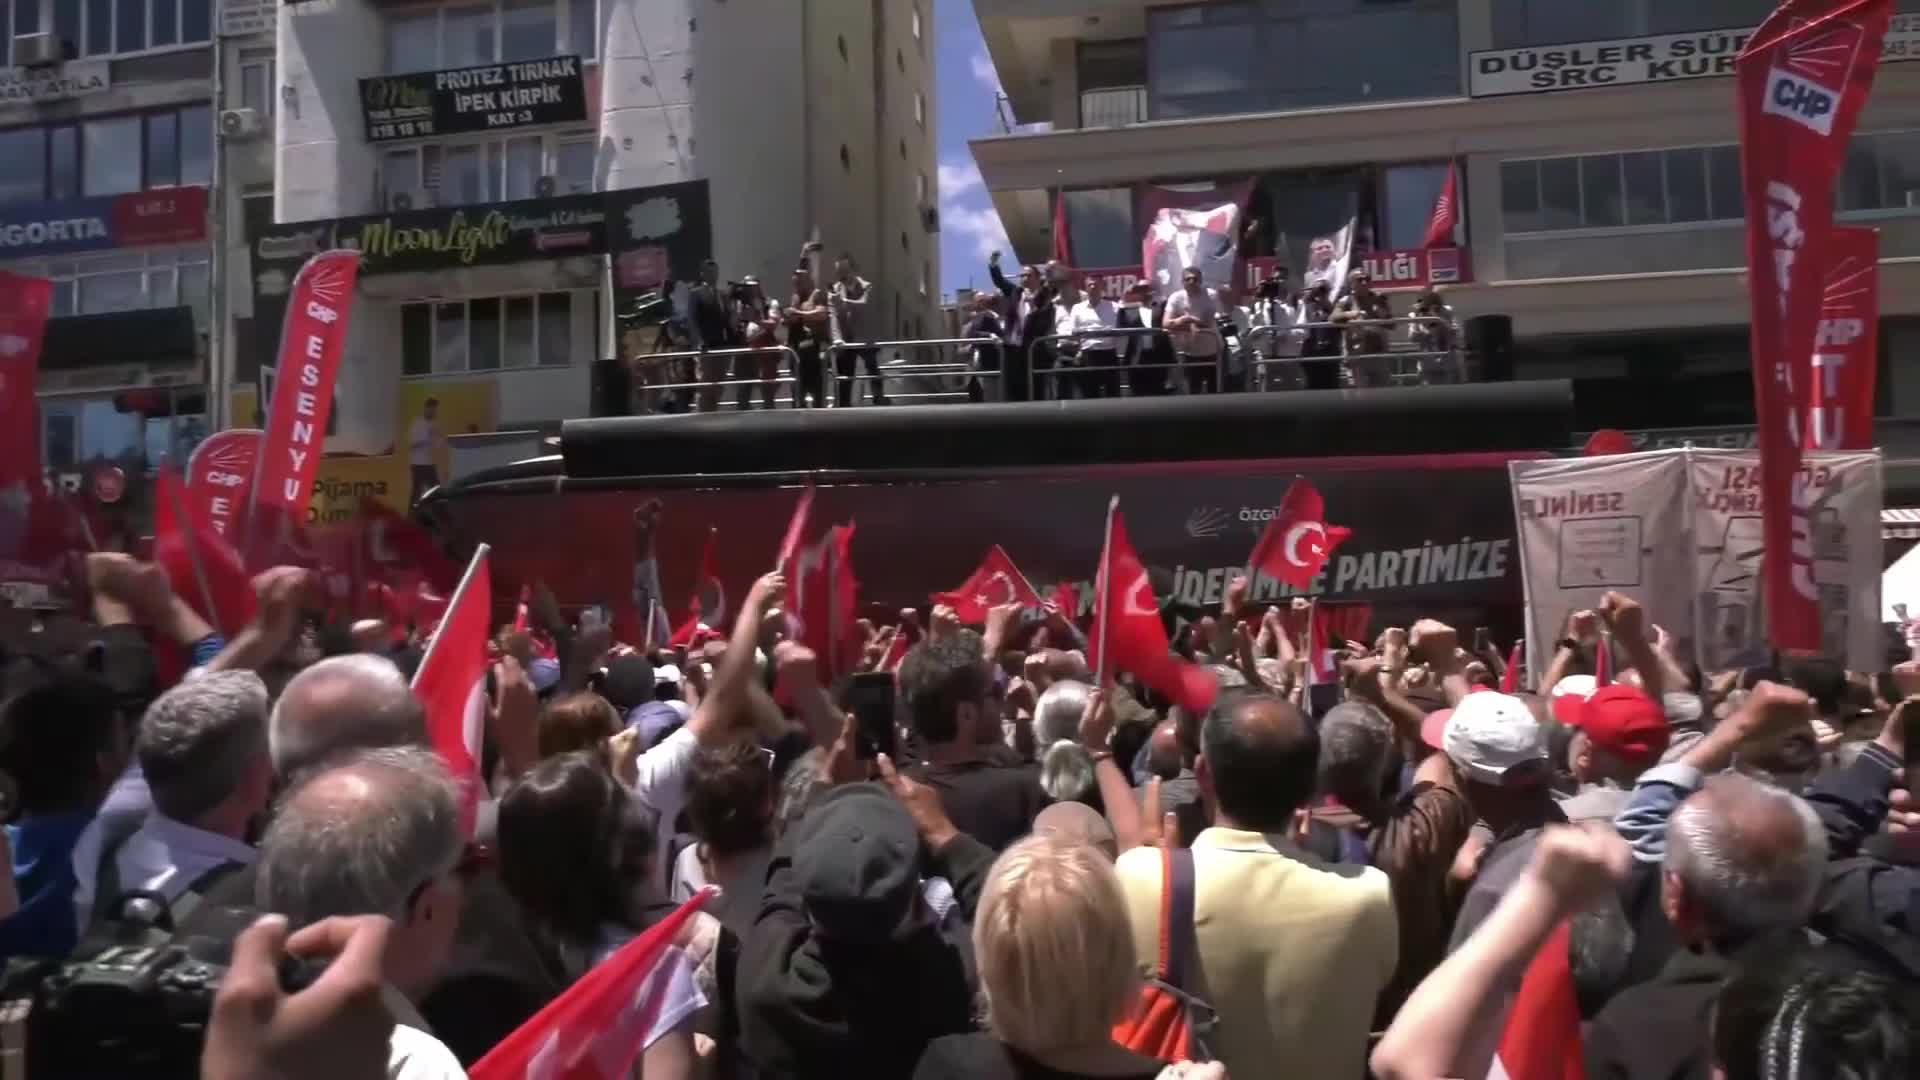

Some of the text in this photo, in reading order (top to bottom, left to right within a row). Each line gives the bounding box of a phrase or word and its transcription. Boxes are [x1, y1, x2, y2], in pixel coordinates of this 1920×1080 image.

[435, 58, 576, 90] PROTEZ TIRNAK
[1479, 43, 1654, 75] DÜŞLER
[1532, 66, 1617, 89] SRC
[455, 90, 496, 113] İPEK
[501, 83, 562, 107] KİRPİK
[1772, 78, 1832, 119] CHP
[488, 112, 516, 126] KAT
[1816, 318, 1863, 346] HP
[1334, 536, 1511, 593] PARTİMİZE
